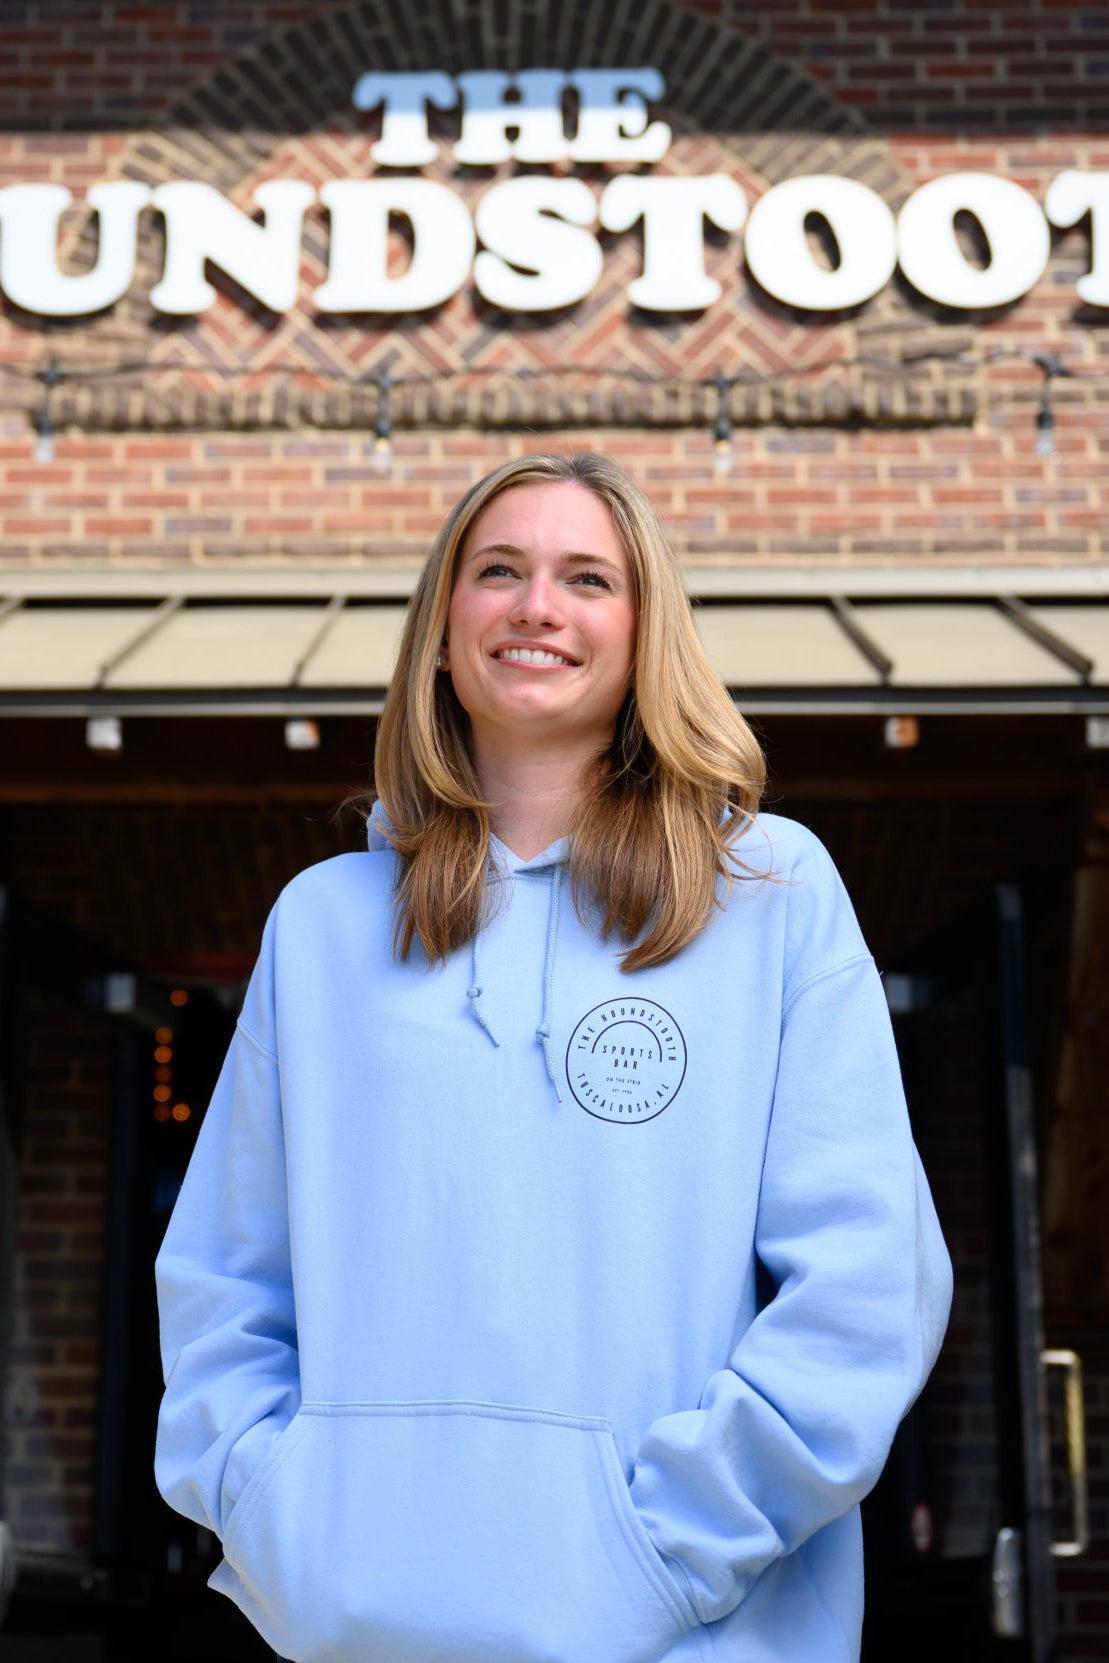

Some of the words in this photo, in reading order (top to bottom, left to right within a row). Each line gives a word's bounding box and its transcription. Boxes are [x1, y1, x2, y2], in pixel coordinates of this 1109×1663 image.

[353, 68, 672, 166] THE
[577, 1026, 595, 1050] THE
[600, 1007, 677, 1061] HOUNDSTOOTH
[602, 1045, 653, 1060] SPORTS
[614, 1059, 638, 1070] BAR
